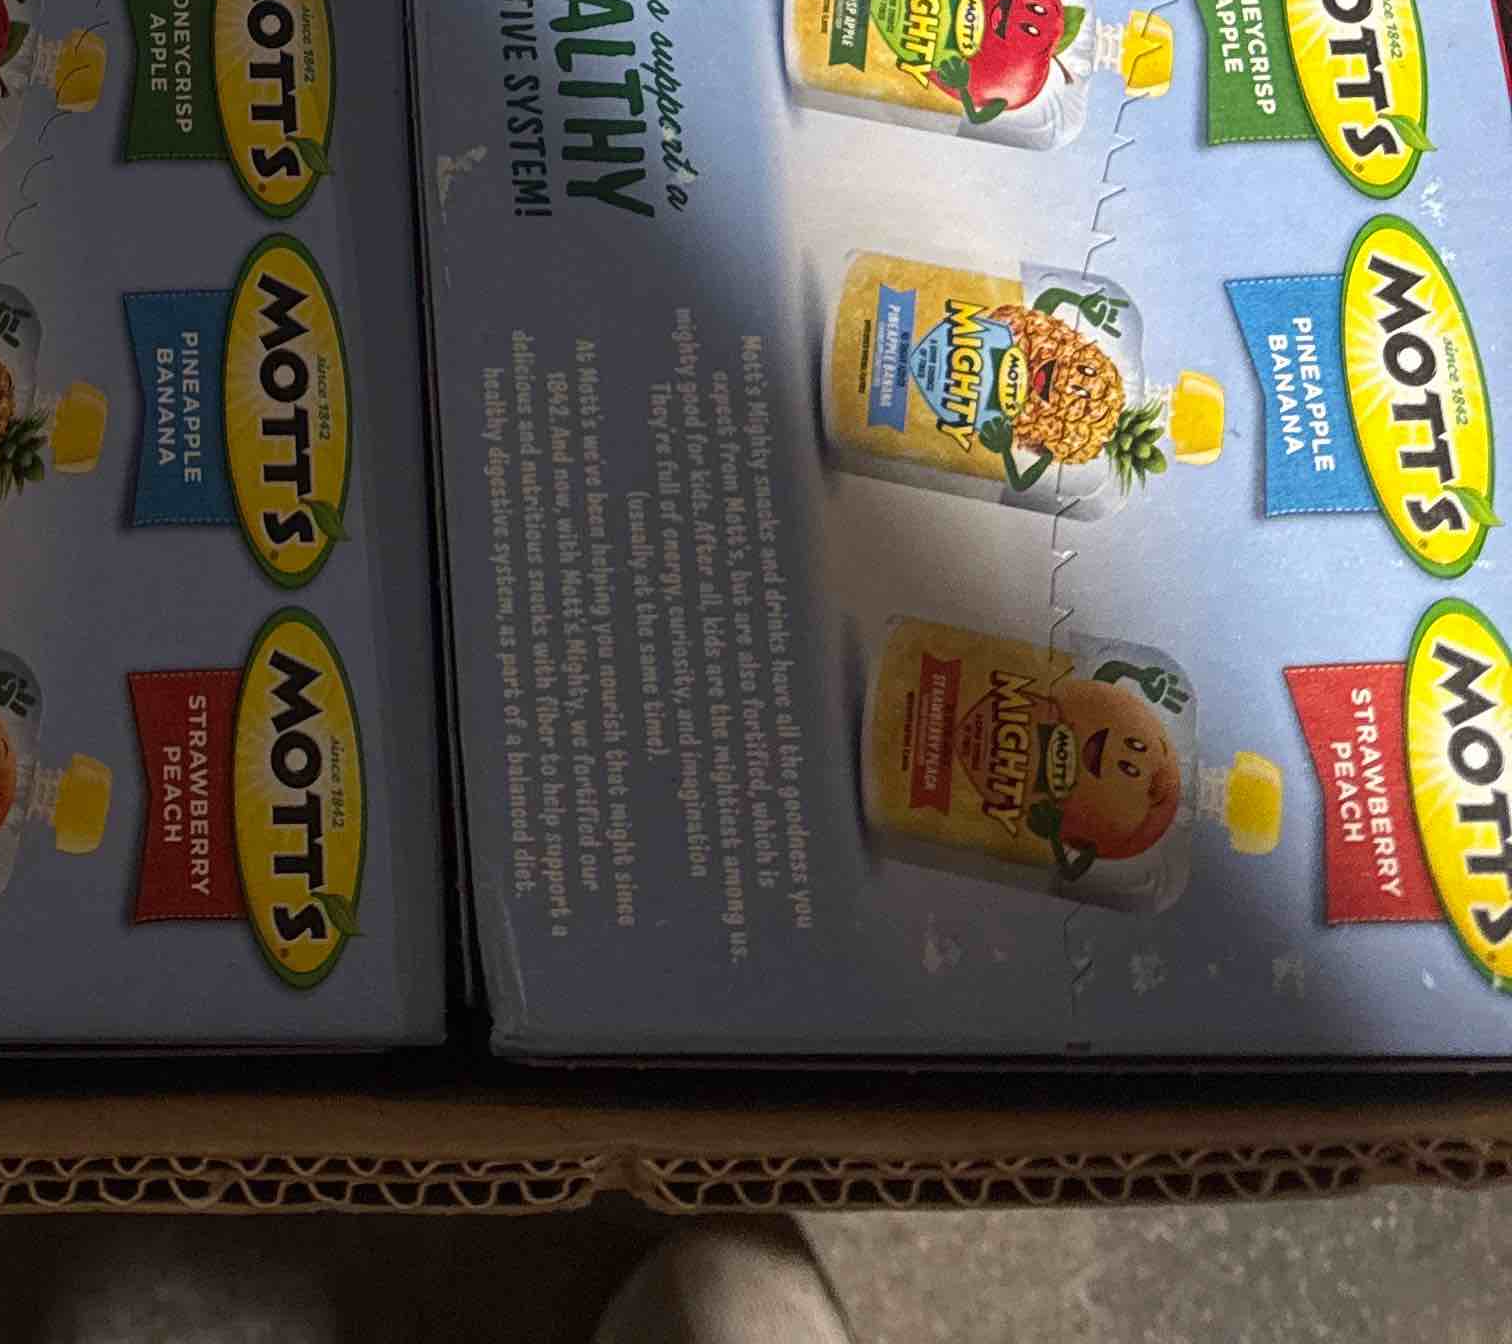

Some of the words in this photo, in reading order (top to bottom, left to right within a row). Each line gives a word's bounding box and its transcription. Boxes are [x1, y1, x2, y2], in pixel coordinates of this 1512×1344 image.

[148, 12, 168, 93] APPLE
[640, 31, 700, 178] support
[1383, 23, 1403, 60] 1842
[502, 73, 553, 218] SYSTEM!
[665, 183, 689, 212] a
[156, 347, 178, 465] BANANA
[180, 331, 202, 483] PINEAPPLE
[257, 272, 316, 543] MOTT'S
[1267, 334, 1305, 456] BANANA
[1291, 317, 1335, 472] PINEAPPLE
[1367, 254, 1466, 534] MOTT'S
[162, 746, 183, 843] PEACH
[188, 694, 210, 896] STRAWBERRY
[268, 649, 326, 942] MOTT'S
[1329, 741, 1364, 843] PEACH
[1350, 687, 1404, 898] STRAWBERRY
